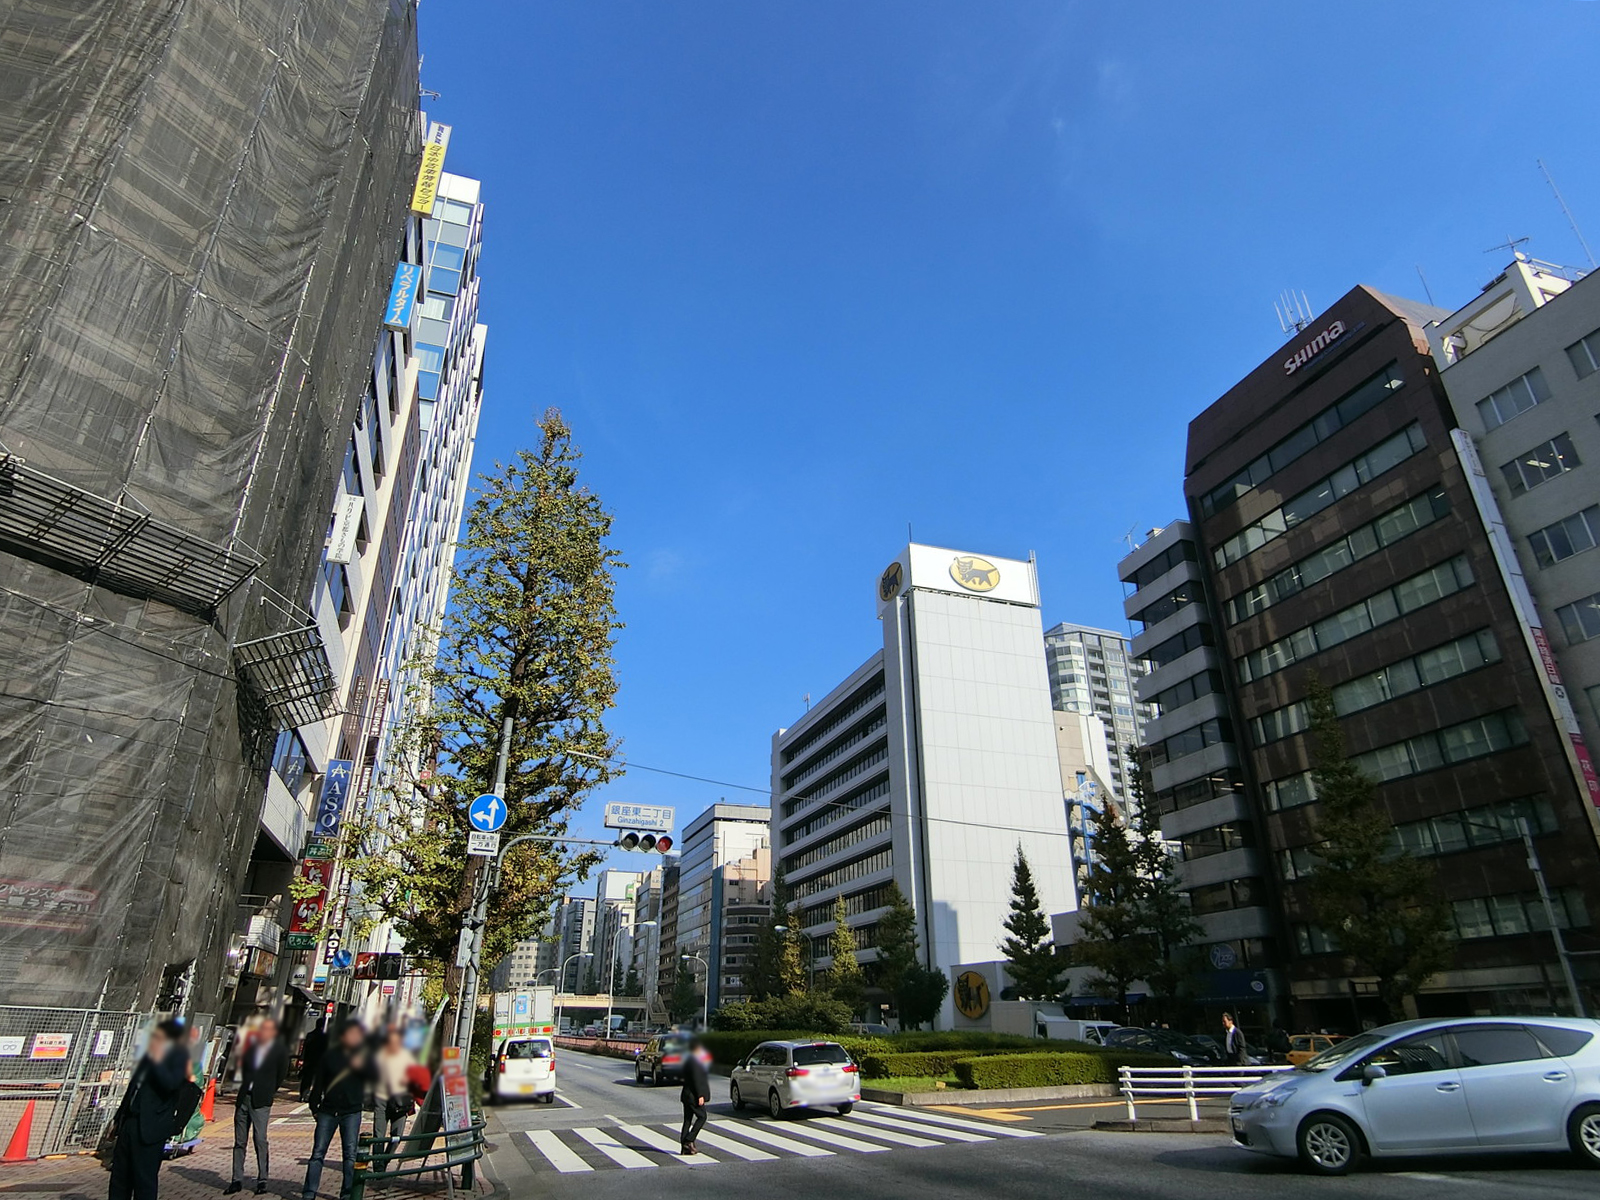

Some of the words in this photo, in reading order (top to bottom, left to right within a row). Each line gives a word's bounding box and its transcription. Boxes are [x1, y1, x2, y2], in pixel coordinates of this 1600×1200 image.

[610, 804, 672, 820] 銀座東二丁目
[617, 816, 658, 827] Ginzahigashi
[659, 819, 664, 827] 2
